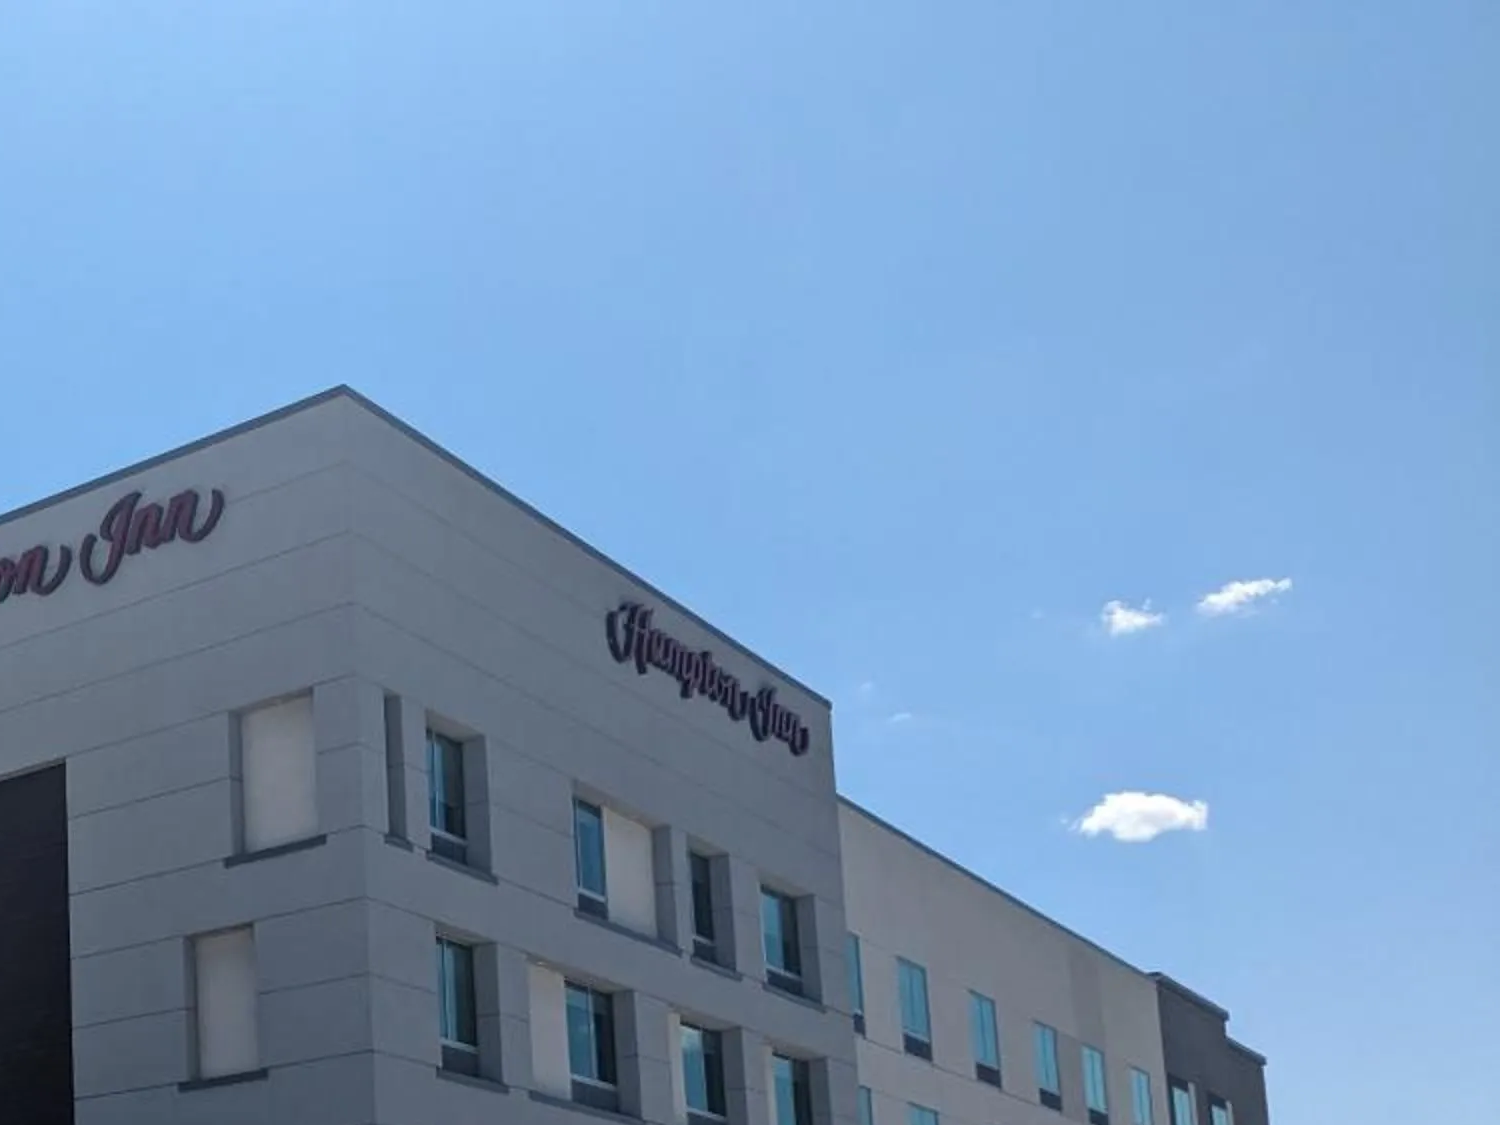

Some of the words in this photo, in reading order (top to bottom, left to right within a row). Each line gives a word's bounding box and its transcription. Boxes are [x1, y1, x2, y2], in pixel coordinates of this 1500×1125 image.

[79, 488, 225, 585] Inn
[606, 601, 749, 721] Hampton
[748, 687, 810, 757] Inn
